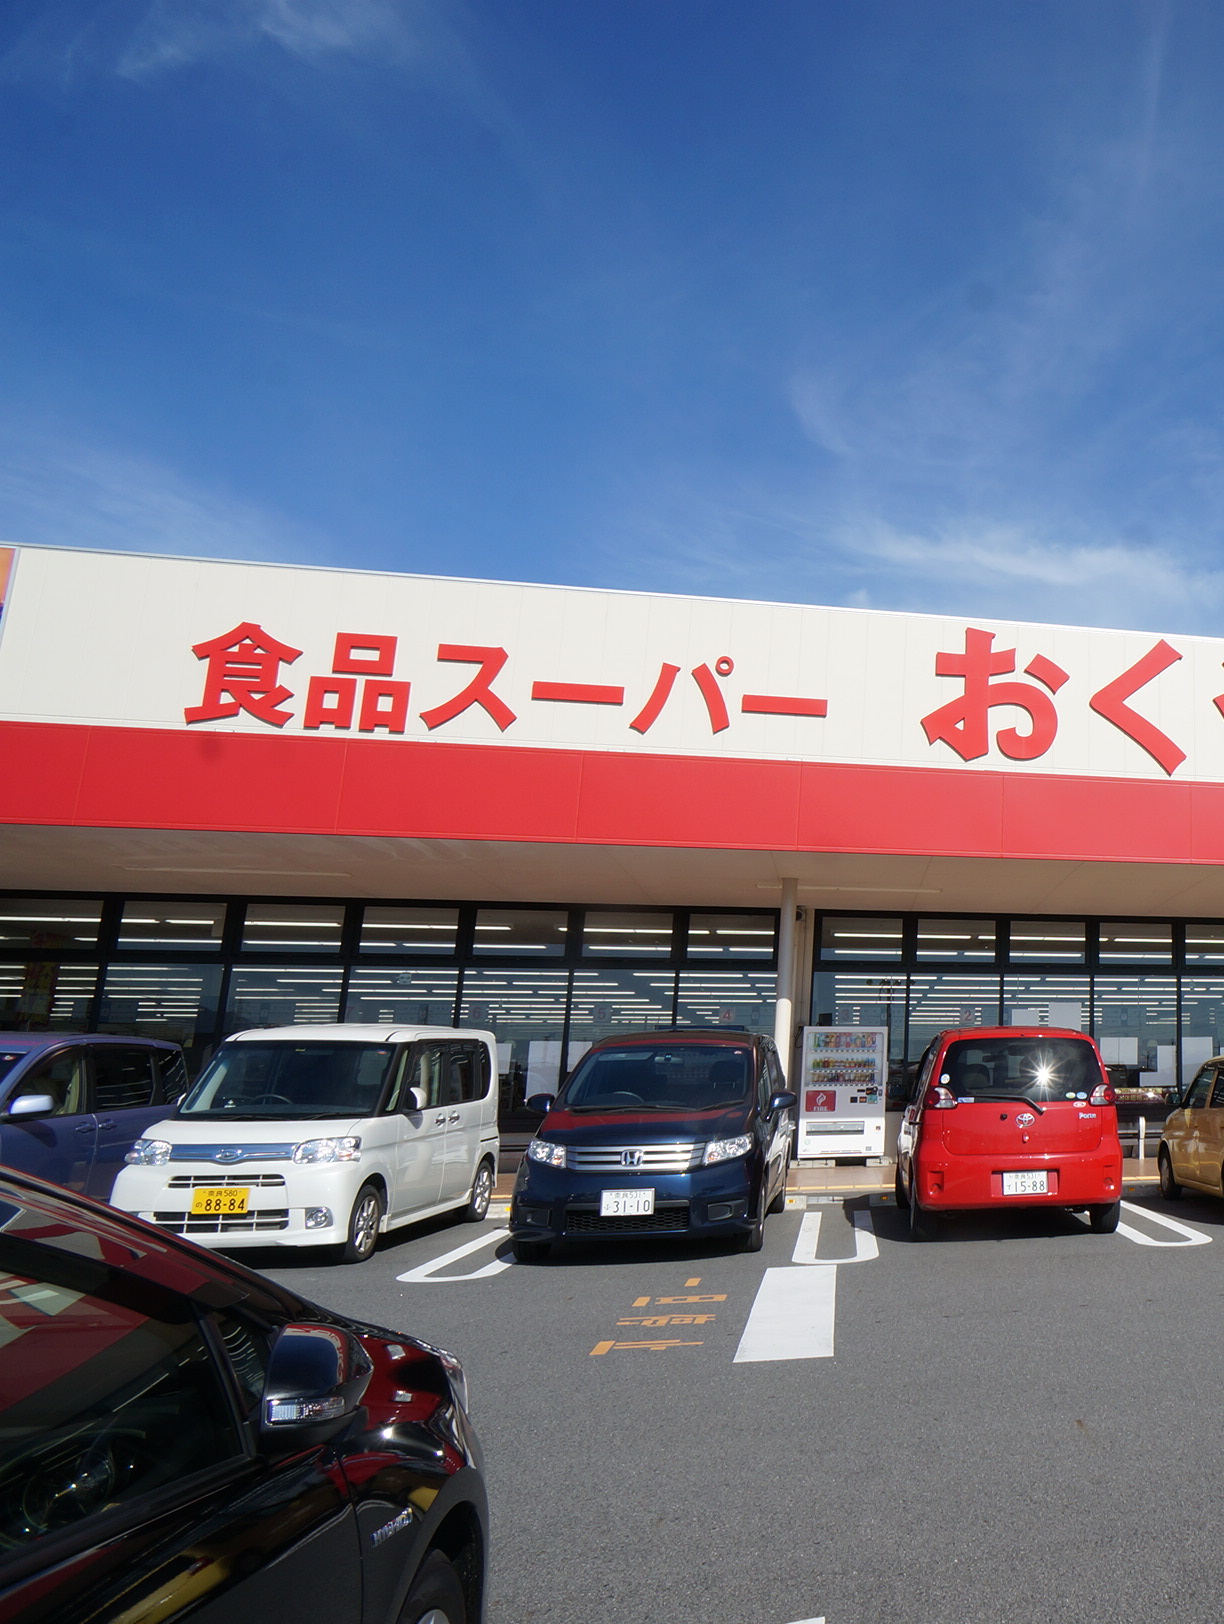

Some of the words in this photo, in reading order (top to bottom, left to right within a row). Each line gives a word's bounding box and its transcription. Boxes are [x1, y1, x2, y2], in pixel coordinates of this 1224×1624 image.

[183, 621, 828, 733] 食品スーパー
